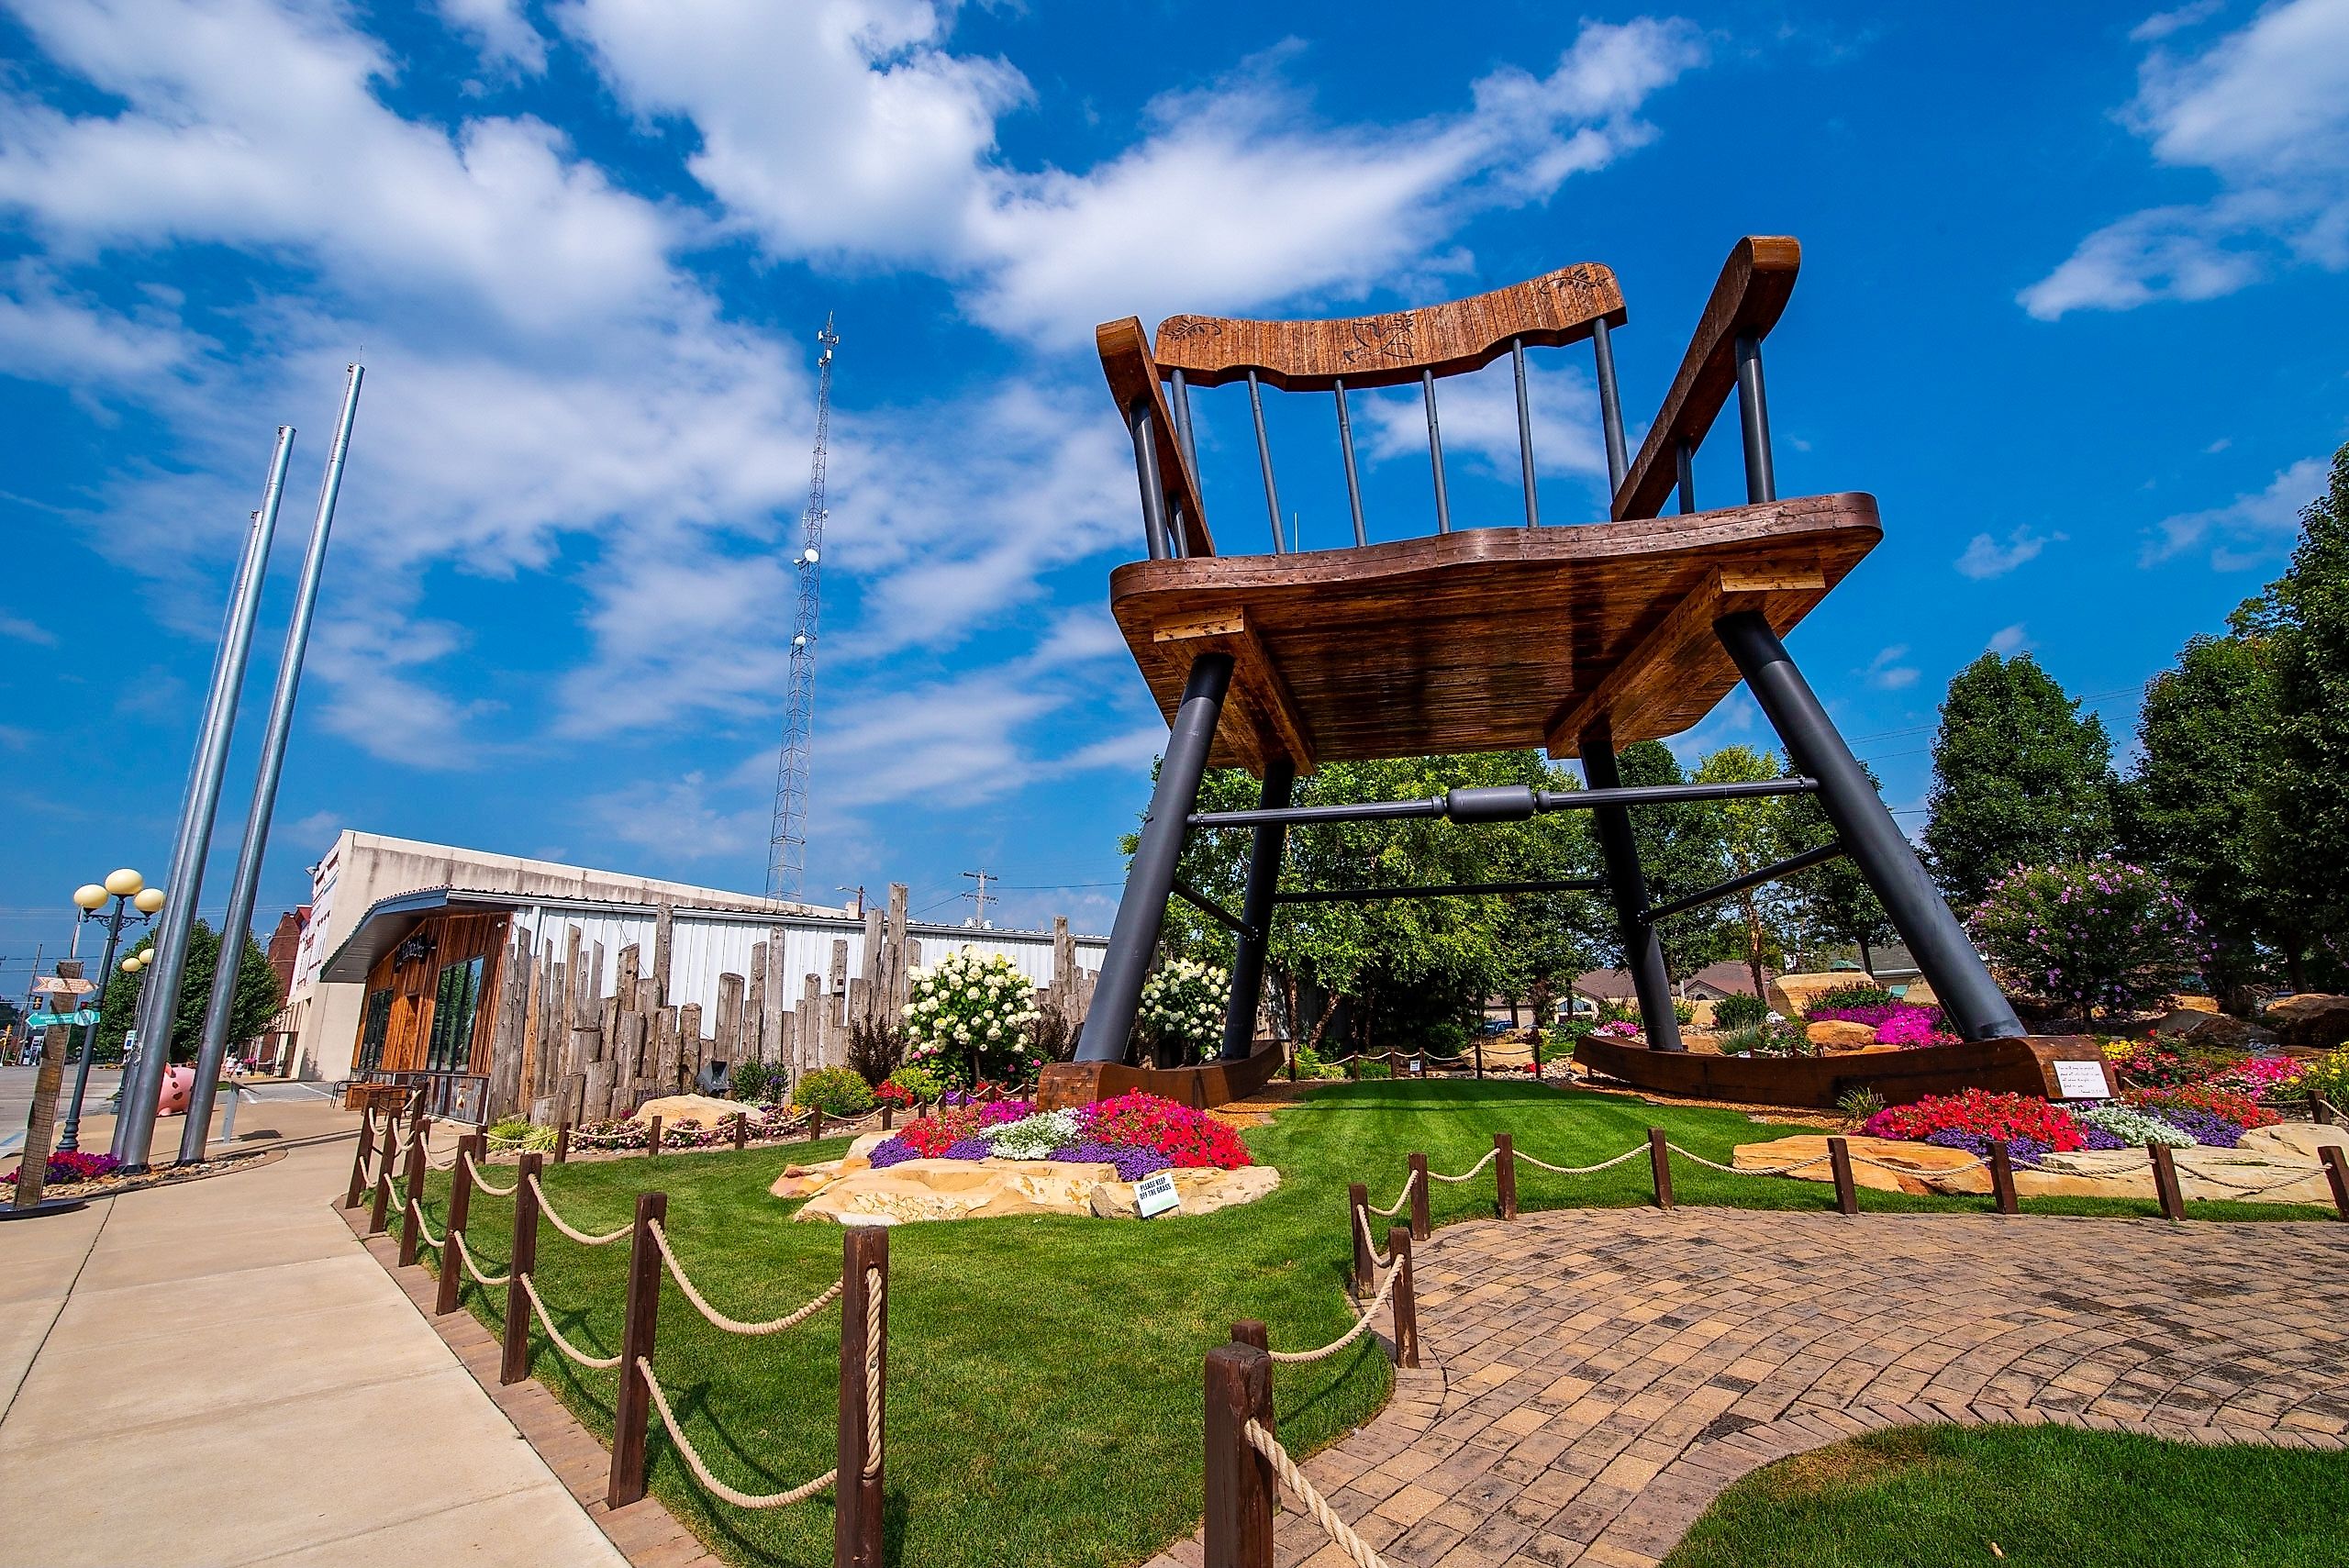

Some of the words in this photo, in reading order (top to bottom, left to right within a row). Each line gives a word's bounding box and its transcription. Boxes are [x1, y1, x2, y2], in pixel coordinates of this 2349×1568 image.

[1140, 1181, 1155, 1192] PLEASE
[1155, 1177, 1165, 1185] KEEP
[1140, 1191, 1148, 1199] OFF
[1156, 1184, 1171, 1193] GRASS
